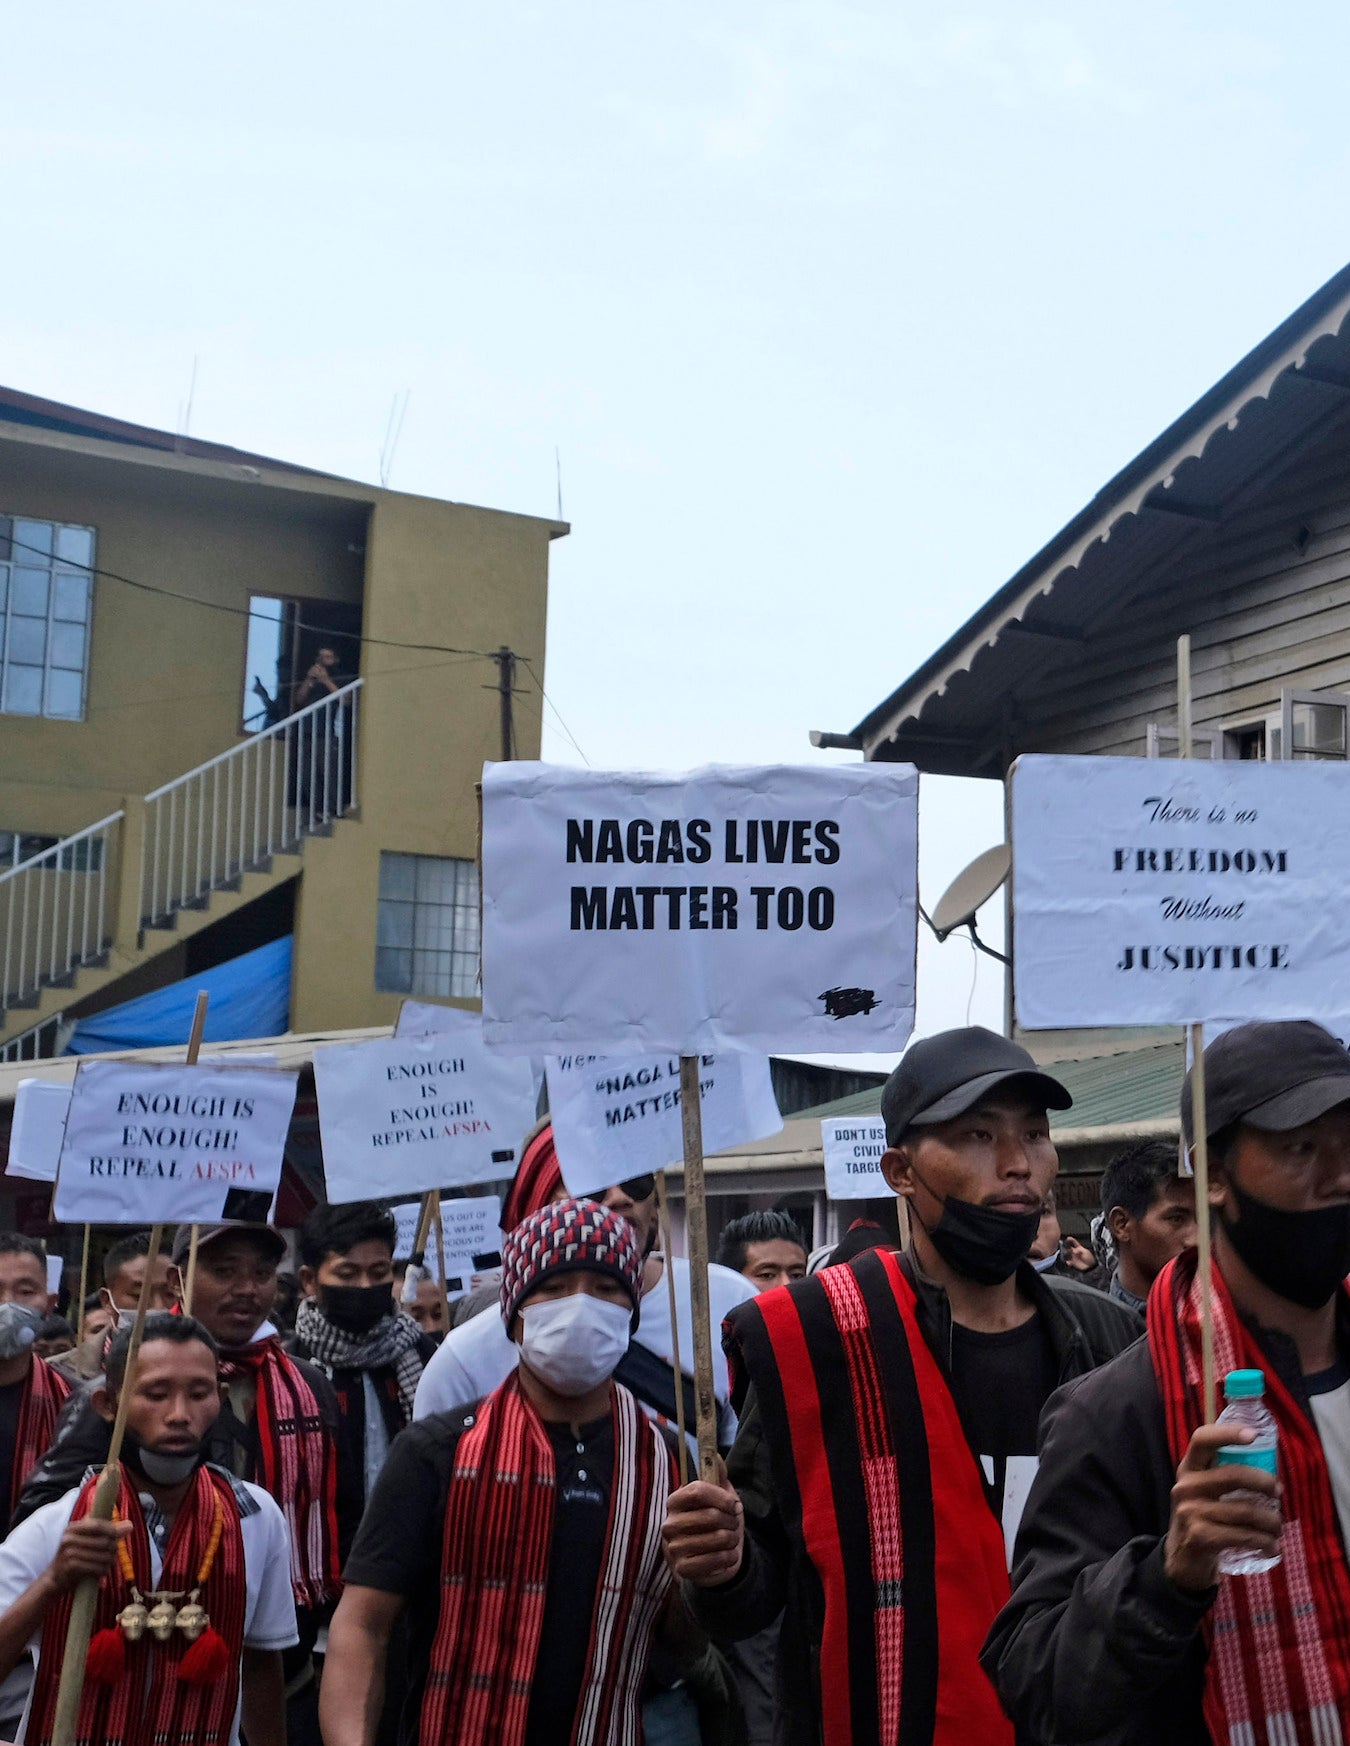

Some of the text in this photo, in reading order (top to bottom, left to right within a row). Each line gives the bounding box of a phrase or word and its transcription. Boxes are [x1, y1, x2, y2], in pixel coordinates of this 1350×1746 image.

[1142, 796, 1259, 824] There is no
[566, 819, 840, 865] NAGAS LIVES
[1113, 848, 1288, 873] FREEDOM
[570, 886, 834, 931] MATTER TOO
[1160, 894, 1246, 921] Without
[1116, 944, 1289, 970] JUSDTICE
[386, 1058, 465, 1080] ENOUGH
[420, 1084, 437, 1098] IS
[117, 1092, 255, 1118] ENOUGH IS
[390, 1100, 474, 1124] ENOUGH!
[122, 1125, 238, 1150] ENOUGH!
[372, 1120, 492, 1147] REPEAL AFSPA
[835, 1128, 886, 1141] DON'T US
[90, 1156, 256, 1181] REPEAL AFSPA
[845, 1162, 880, 1174] TARGE
